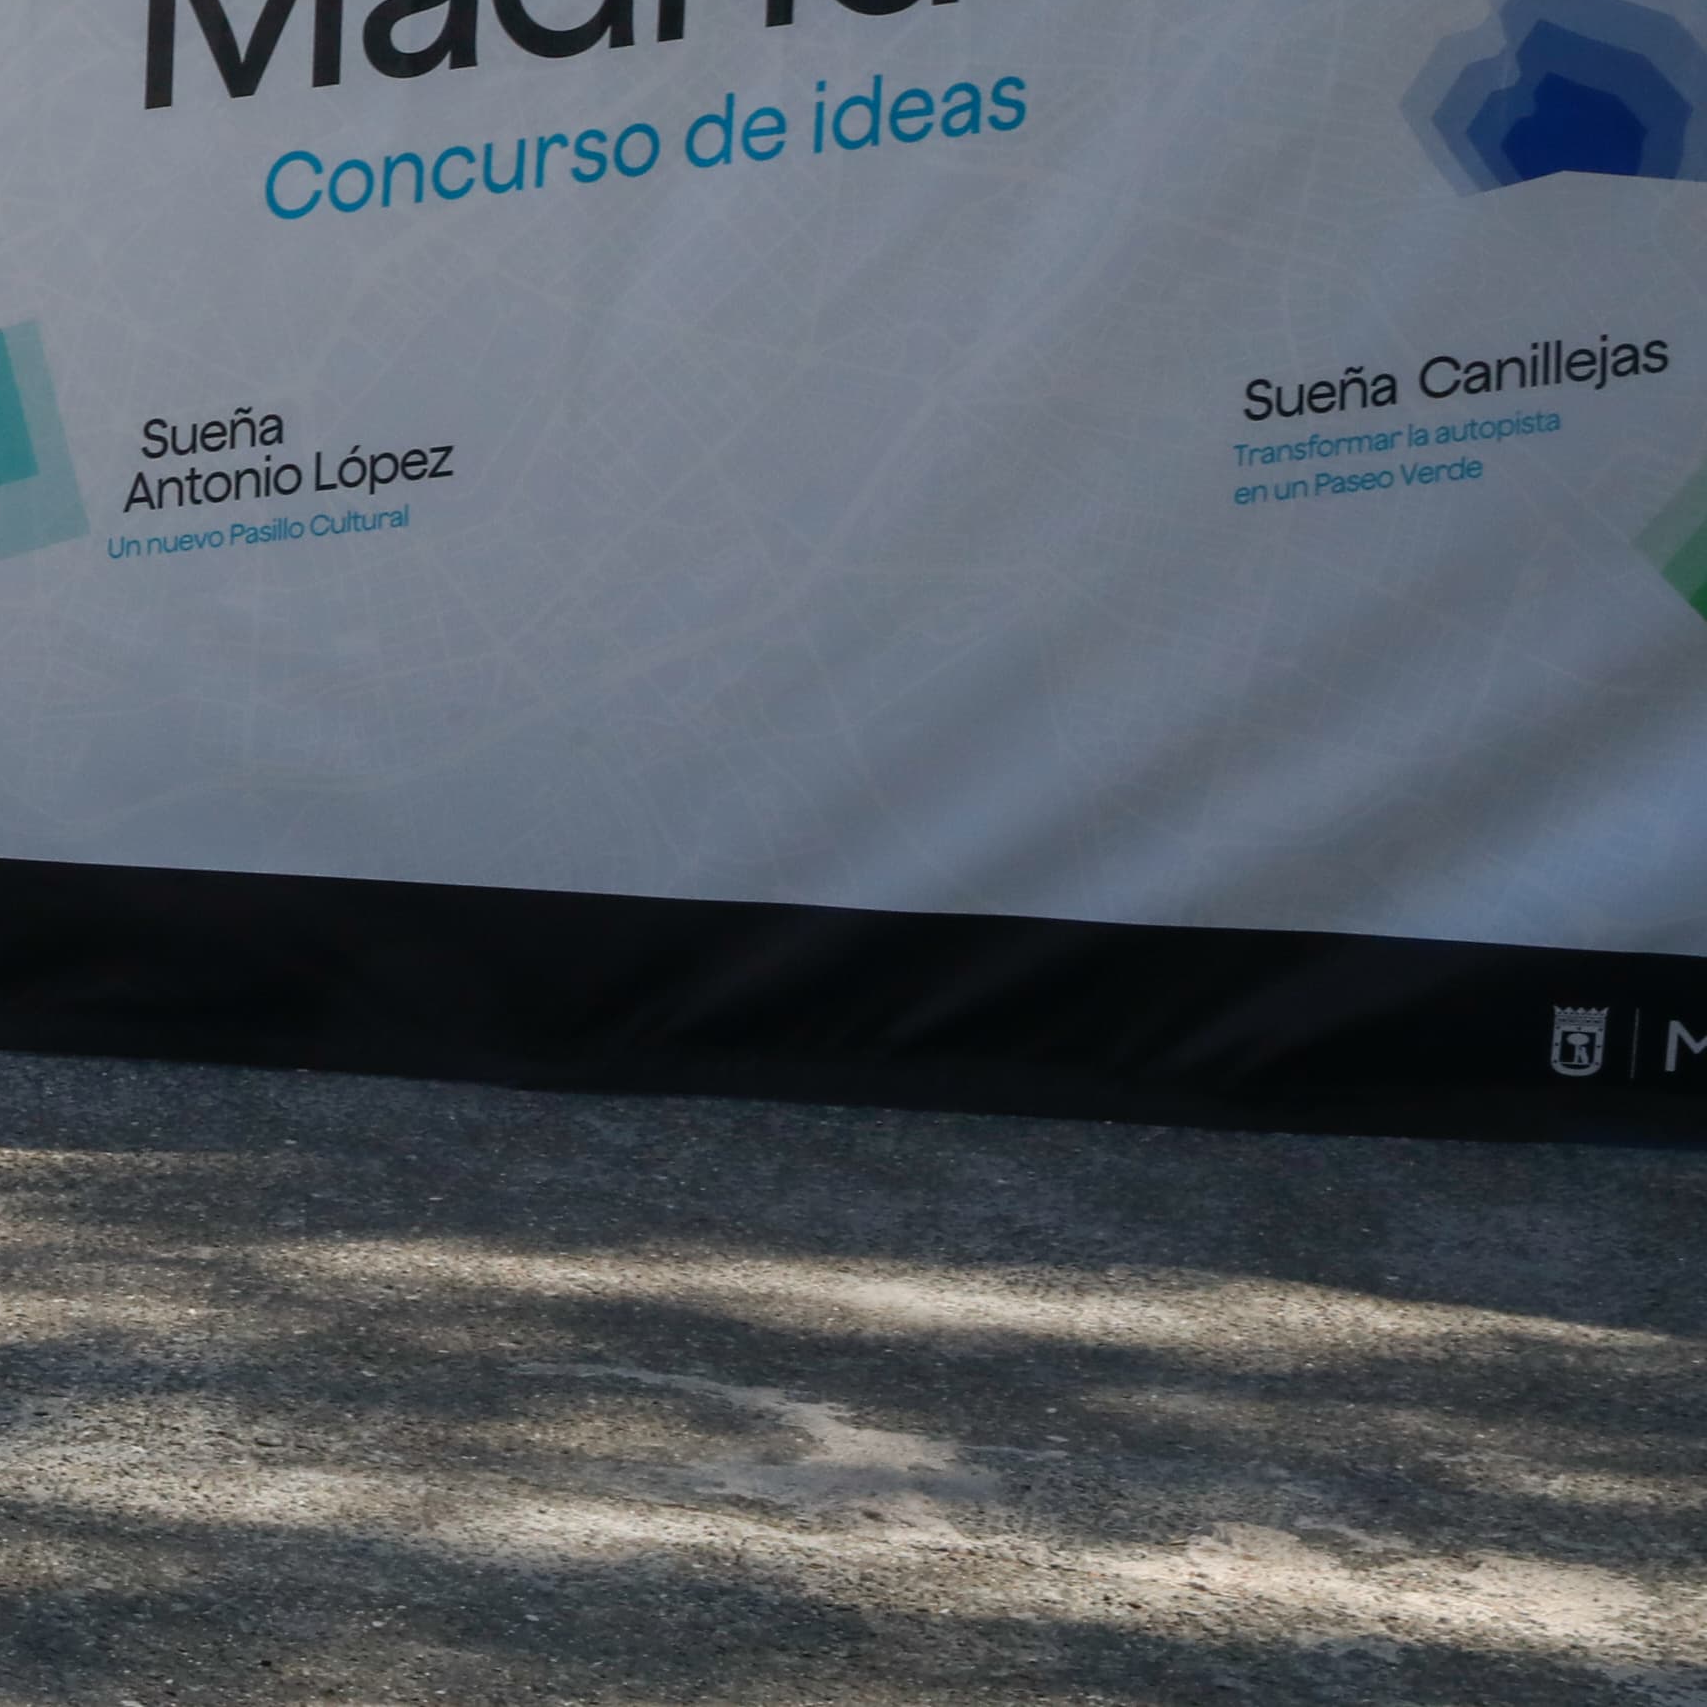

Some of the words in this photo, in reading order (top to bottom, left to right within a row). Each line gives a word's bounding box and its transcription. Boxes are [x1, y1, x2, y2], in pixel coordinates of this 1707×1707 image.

[264, 122, 660, 220] Concurso
[684, 94, 787, 168] de
[813, 74, 1028, 154] ideas
[1243, 365, 1397, 421] Sueña
[1418, 334, 1669, 398] Canillejas
[141, 406, 283, 459] Sueña
[1234, 427, 1402, 467] Transformar
[1407, 423, 1429, 447] la
[1435, 410, 1561, 444] autopista
[123, 455, 302, 513] Antonio
[314, 445, 454, 494] López
[1234, 482, 1267, 505] en
[1274, 477, 1308, 501] un
[1315, 469, 1394, 496] Paseo
[1401, 456, 1483, 486] Verde
[107, 536, 140, 559] Un
[147, 529, 224, 556] nuevo
[230, 518, 304, 546] Pasillo
[310, 505, 410, 536] Cultural
